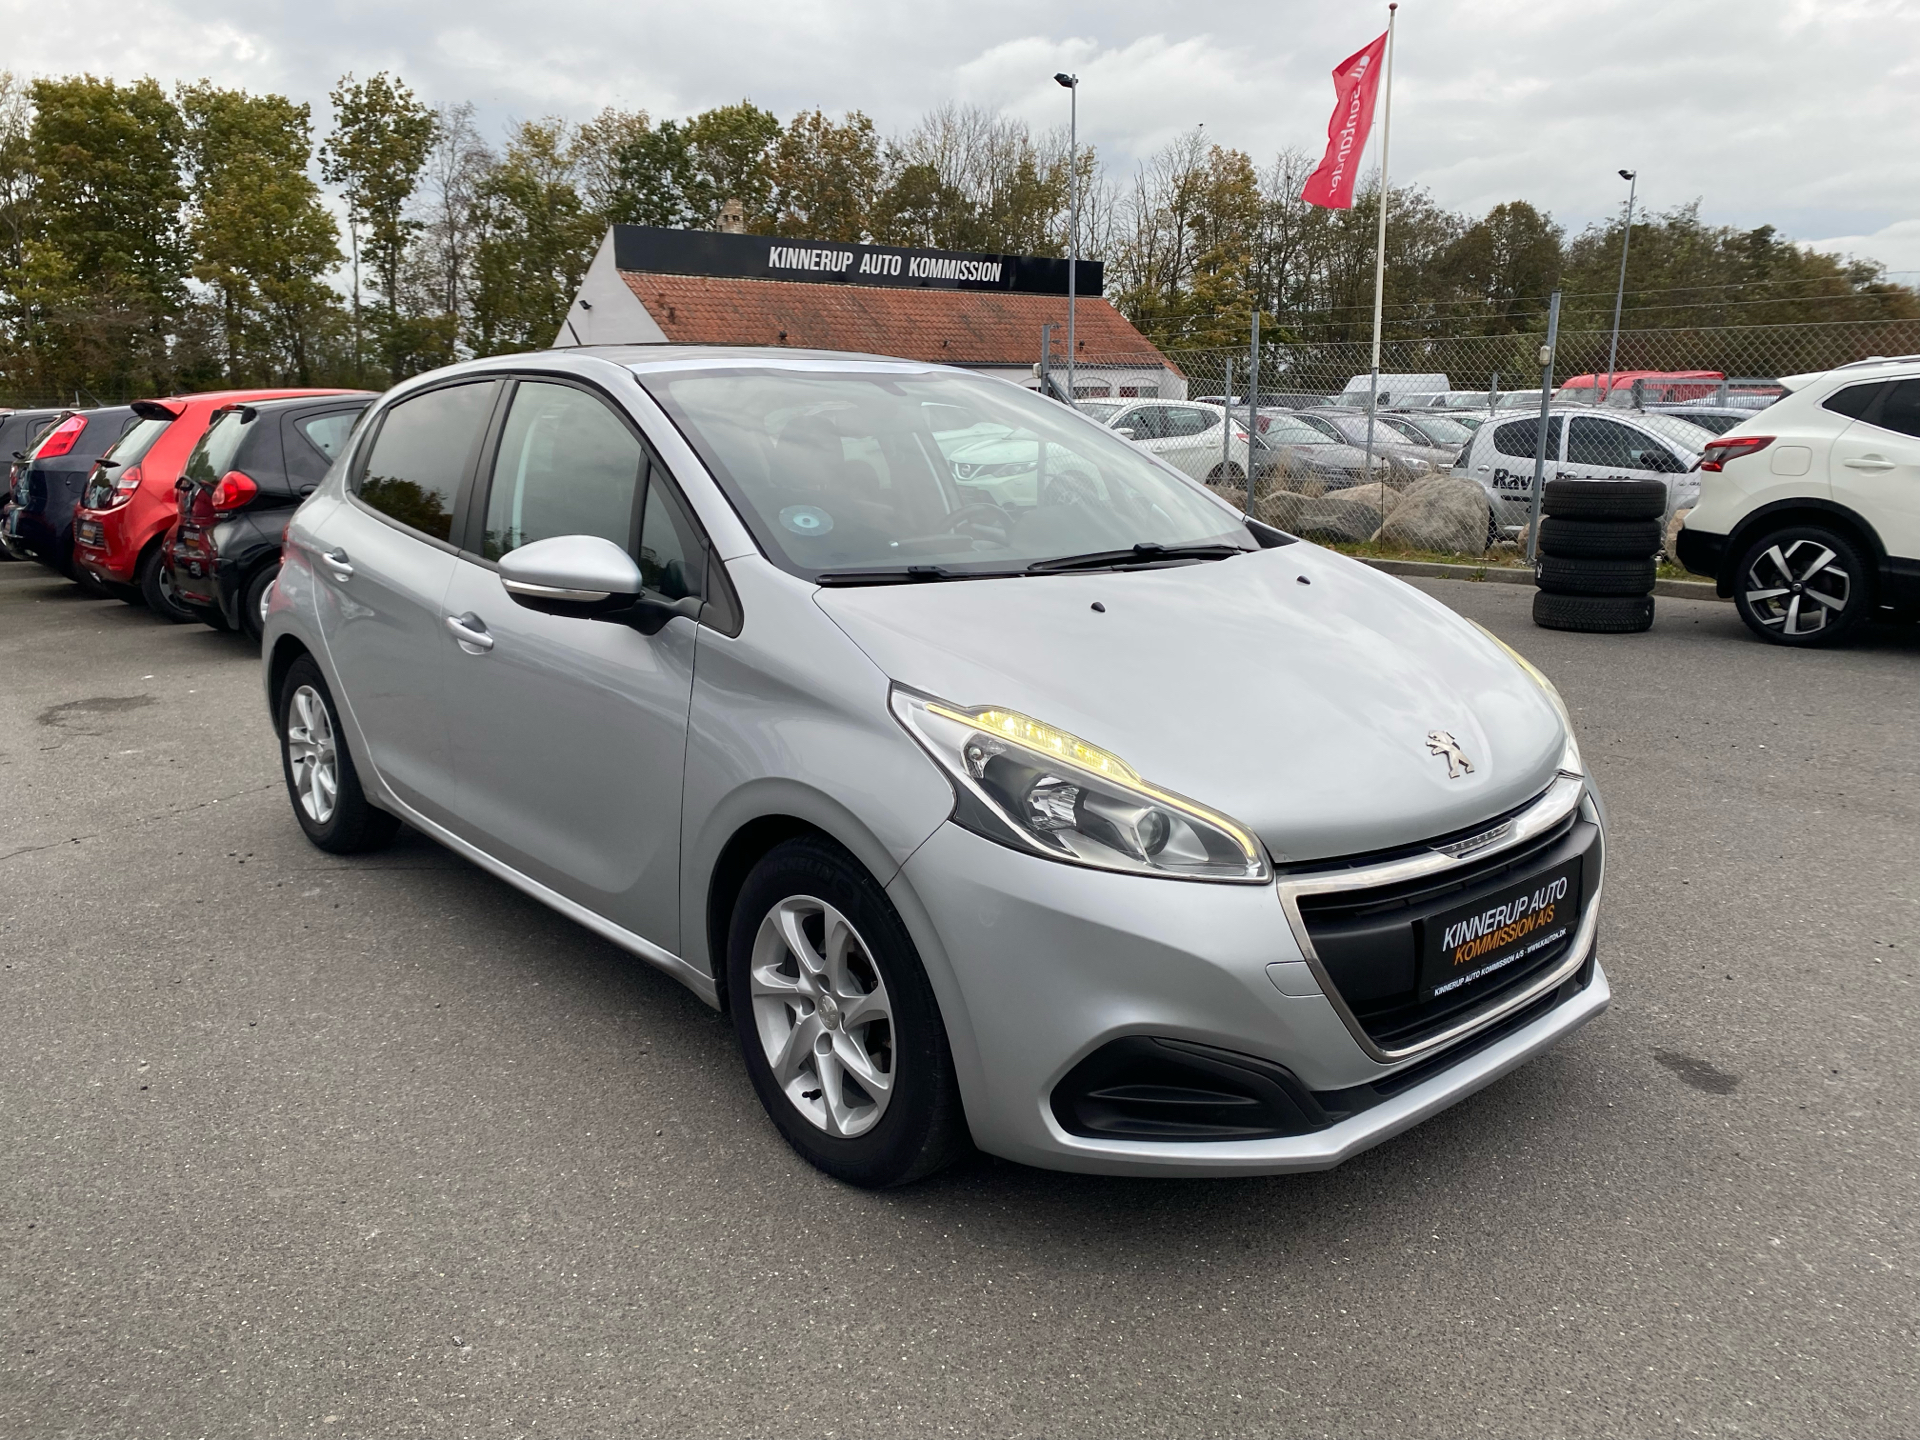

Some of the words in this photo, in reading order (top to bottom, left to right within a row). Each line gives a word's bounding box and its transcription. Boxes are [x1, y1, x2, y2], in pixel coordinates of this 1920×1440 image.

[768, 246, 854, 273] KINNERUP
[859, 253, 902, 276] AUTO
[908, 256, 1003, 282] KOMMISSION
[1442, 896, 1529, 952] KINNERUP
[1528, 876, 1568, 914] AUTO
[1454, 914, 1537, 966] KOMMISSION
[1535, 904, 1555, 929] A/S
[1434, 977, 1465, 997] KINNERUP
[1464, 970, 1481, 984] AUTO
[1481, 953, 1515, 976] KOMMISSION
